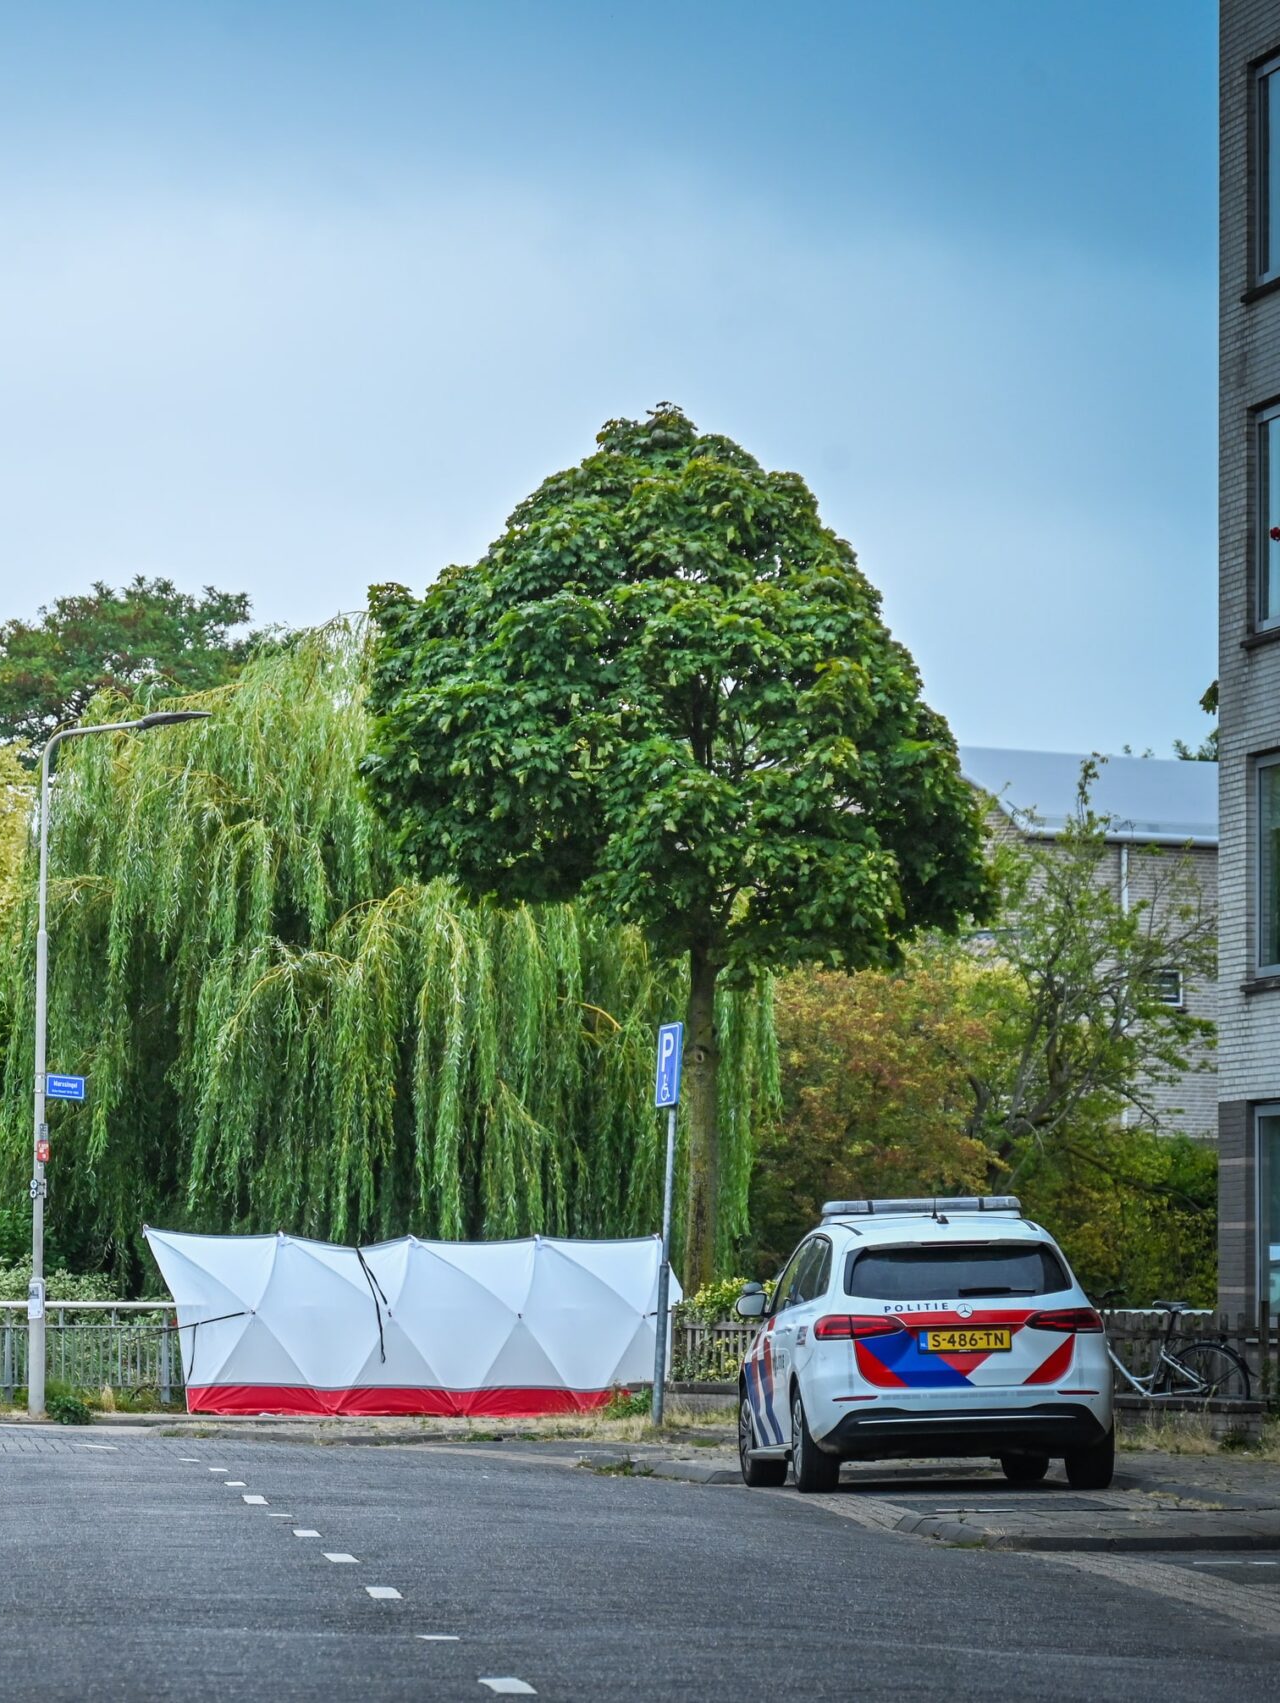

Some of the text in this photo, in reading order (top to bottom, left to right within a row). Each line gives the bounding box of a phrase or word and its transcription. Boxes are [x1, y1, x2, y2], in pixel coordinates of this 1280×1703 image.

[662, 1033, 674, 1073] P
[884, 1302, 949, 1313] POLITIE
[932, 1332, 1005, 1348] S-486-TN
